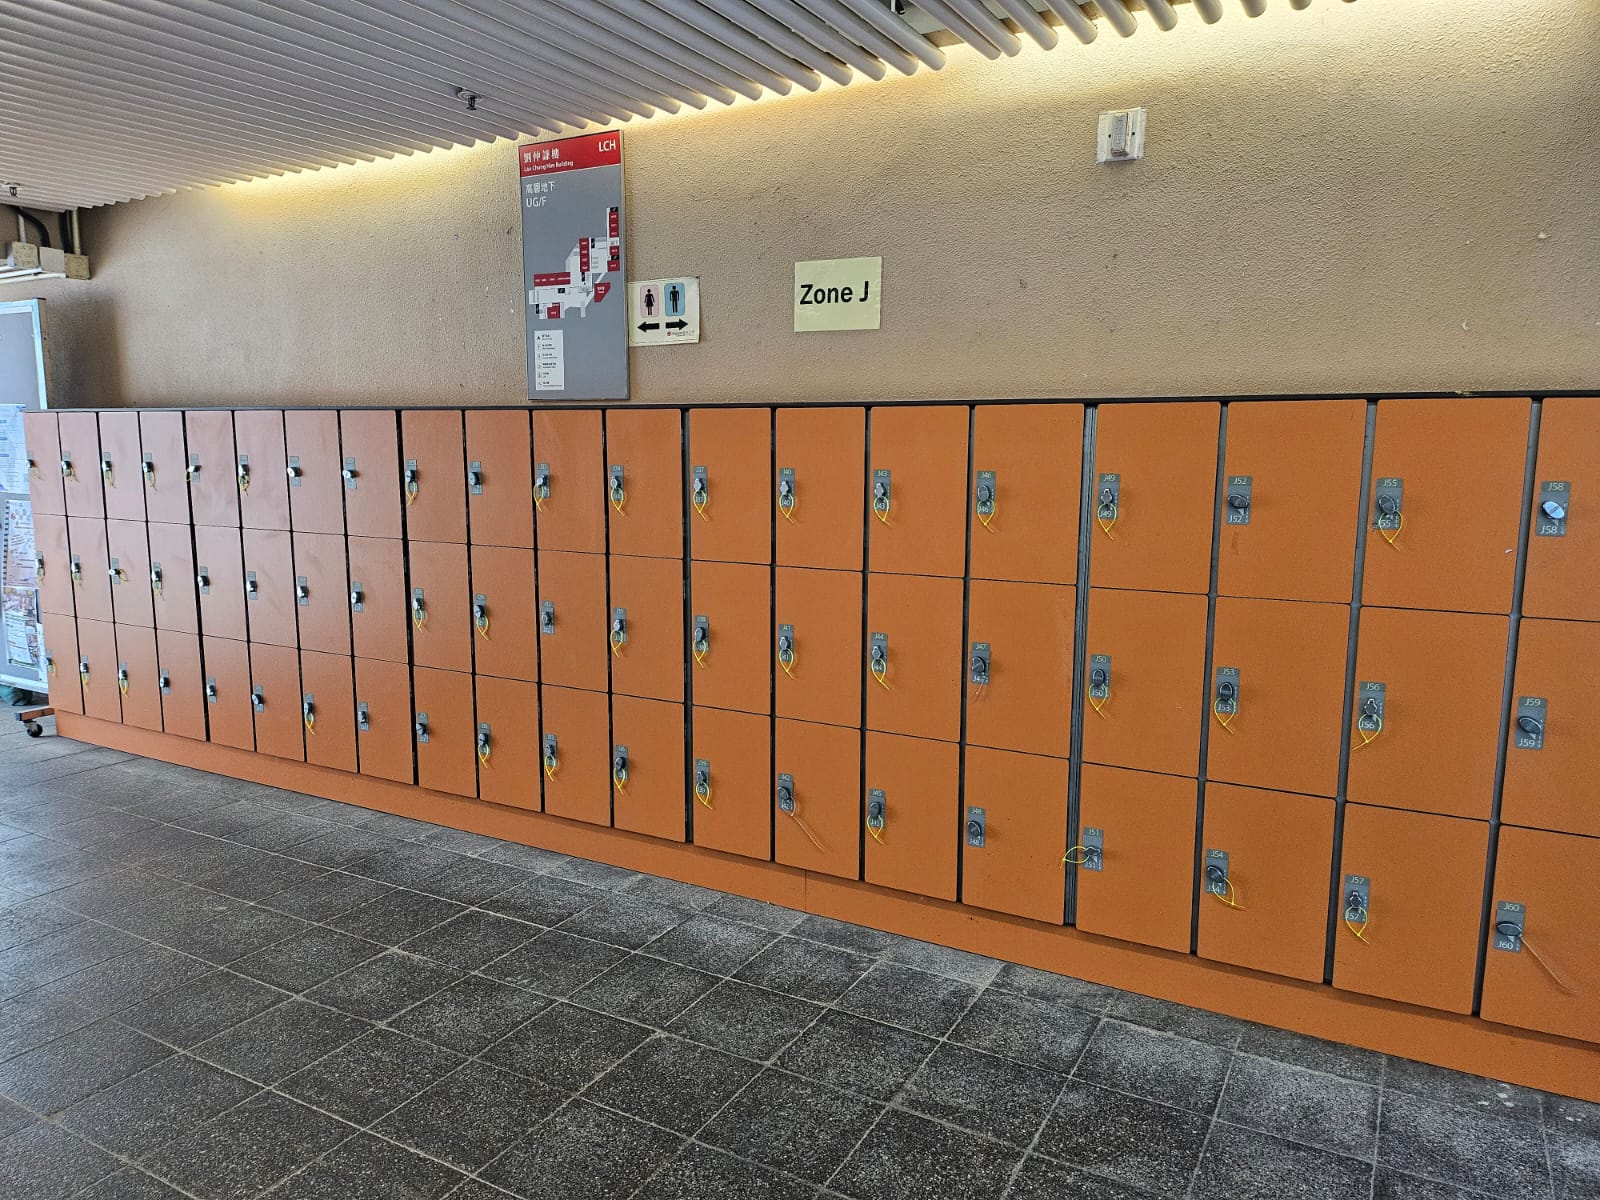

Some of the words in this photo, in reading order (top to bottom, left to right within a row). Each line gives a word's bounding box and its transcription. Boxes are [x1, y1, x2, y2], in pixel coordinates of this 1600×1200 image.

[598, 139, 616, 152] LCH
[526, 196, 547, 208] UG/F
[800, 284, 853, 305] Zone
[859, 280, 869, 302] J
[1103, 474, 1116, 482] J49
[1232, 477, 1247, 485] J52
[1383, 479, 1398, 487] J55
[1547, 482, 1564, 491] J58
[1100, 510, 1112, 518] J49
[1228, 515, 1243, 523] J52
[1540, 525, 1558, 534] J58
[1095, 655, 1107, 663] J50
[1223, 668, 1236, 676] J53
[1366, 683, 1381, 691] J56
[1091, 689, 1103, 697] J50
[1524, 697, 1541, 706] J59
[1217, 704, 1231, 712] J53
[1360, 720, 1375, 729] J56
[1518, 738, 1535, 747] J59
[1087, 828, 1099, 836] J51
[1211, 850, 1223, 858] J54
[1084, 861, 1096, 869] J51
[1351, 876, 1365, 885] J57
[1503, 902, 1520, 912] J60
[1497, 941, 1514, 950] J60
